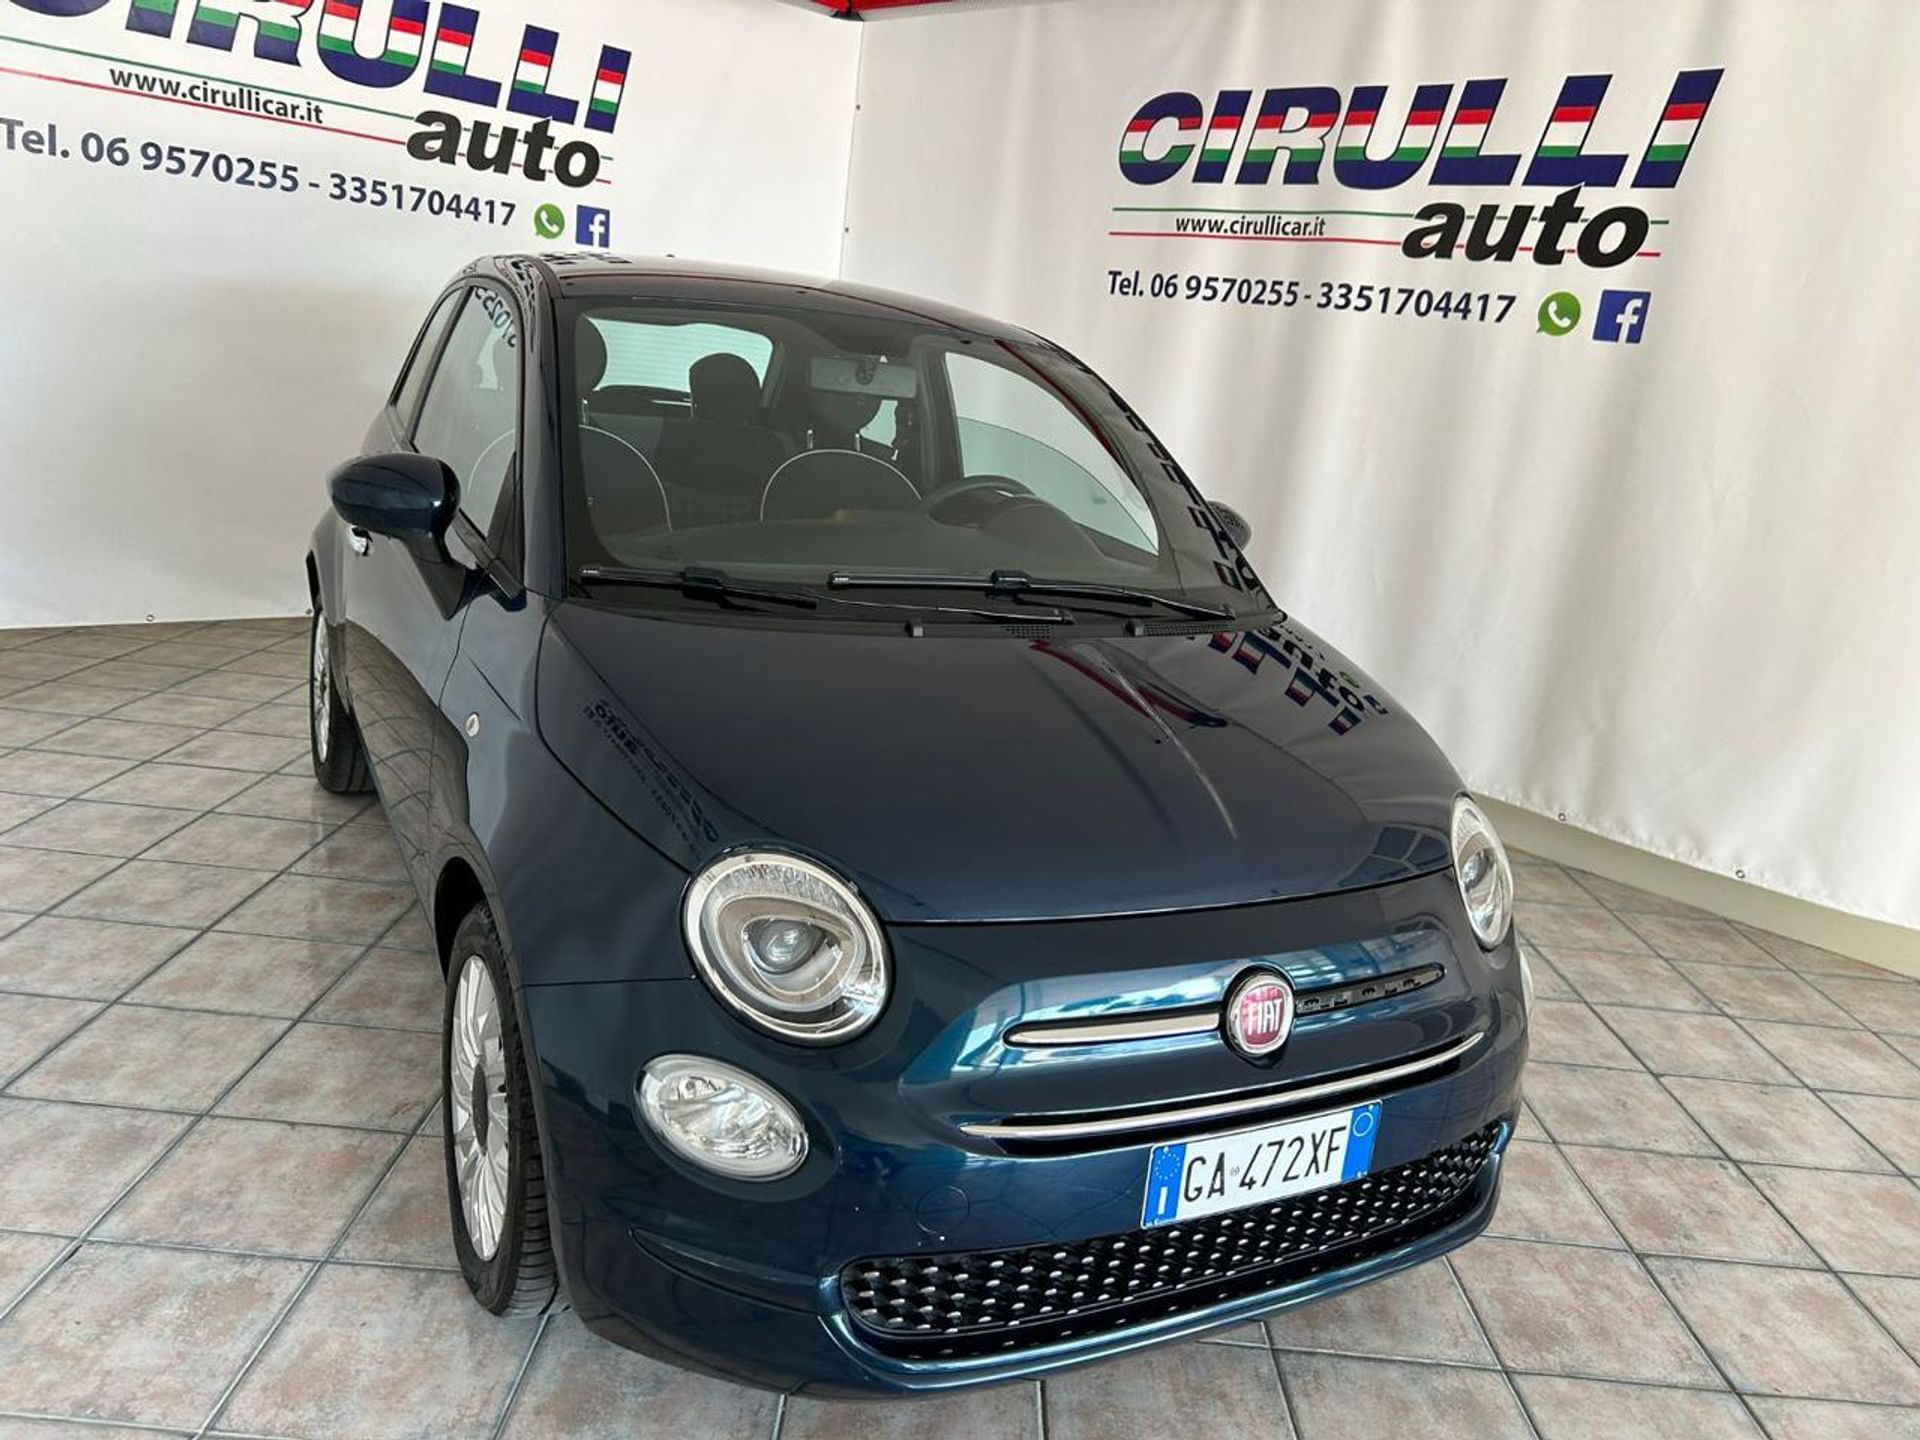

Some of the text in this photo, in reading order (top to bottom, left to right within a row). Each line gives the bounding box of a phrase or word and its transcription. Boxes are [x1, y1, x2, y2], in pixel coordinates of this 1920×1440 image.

[109, 68, 324, 124] www.cirullicar.it
[1118, 68, 1726, 190] CIRULLI
[0, 117, 70, 159] Tel.
[80, 132, 130, 167] 06
[140, 141, 299, 193] 9570255
[328, 172, 516, 227] 3351704417
[406, 110, 601, 189] auto
[1175, 213, 1326, 238] www.cirullicar.it
[1400, 182, 1650, 268] auto
[1107, 270, 1145, 298] Tel.
[1150, 272, 1179, 299] 06
[1184, 274, 1299, 308] 9570255
[1316, 281, 1517, 324] 3351704417
[1247, 998, 1283, 1036] FIAT
[1183, 1125, 1348, 1203] GA 472XF
